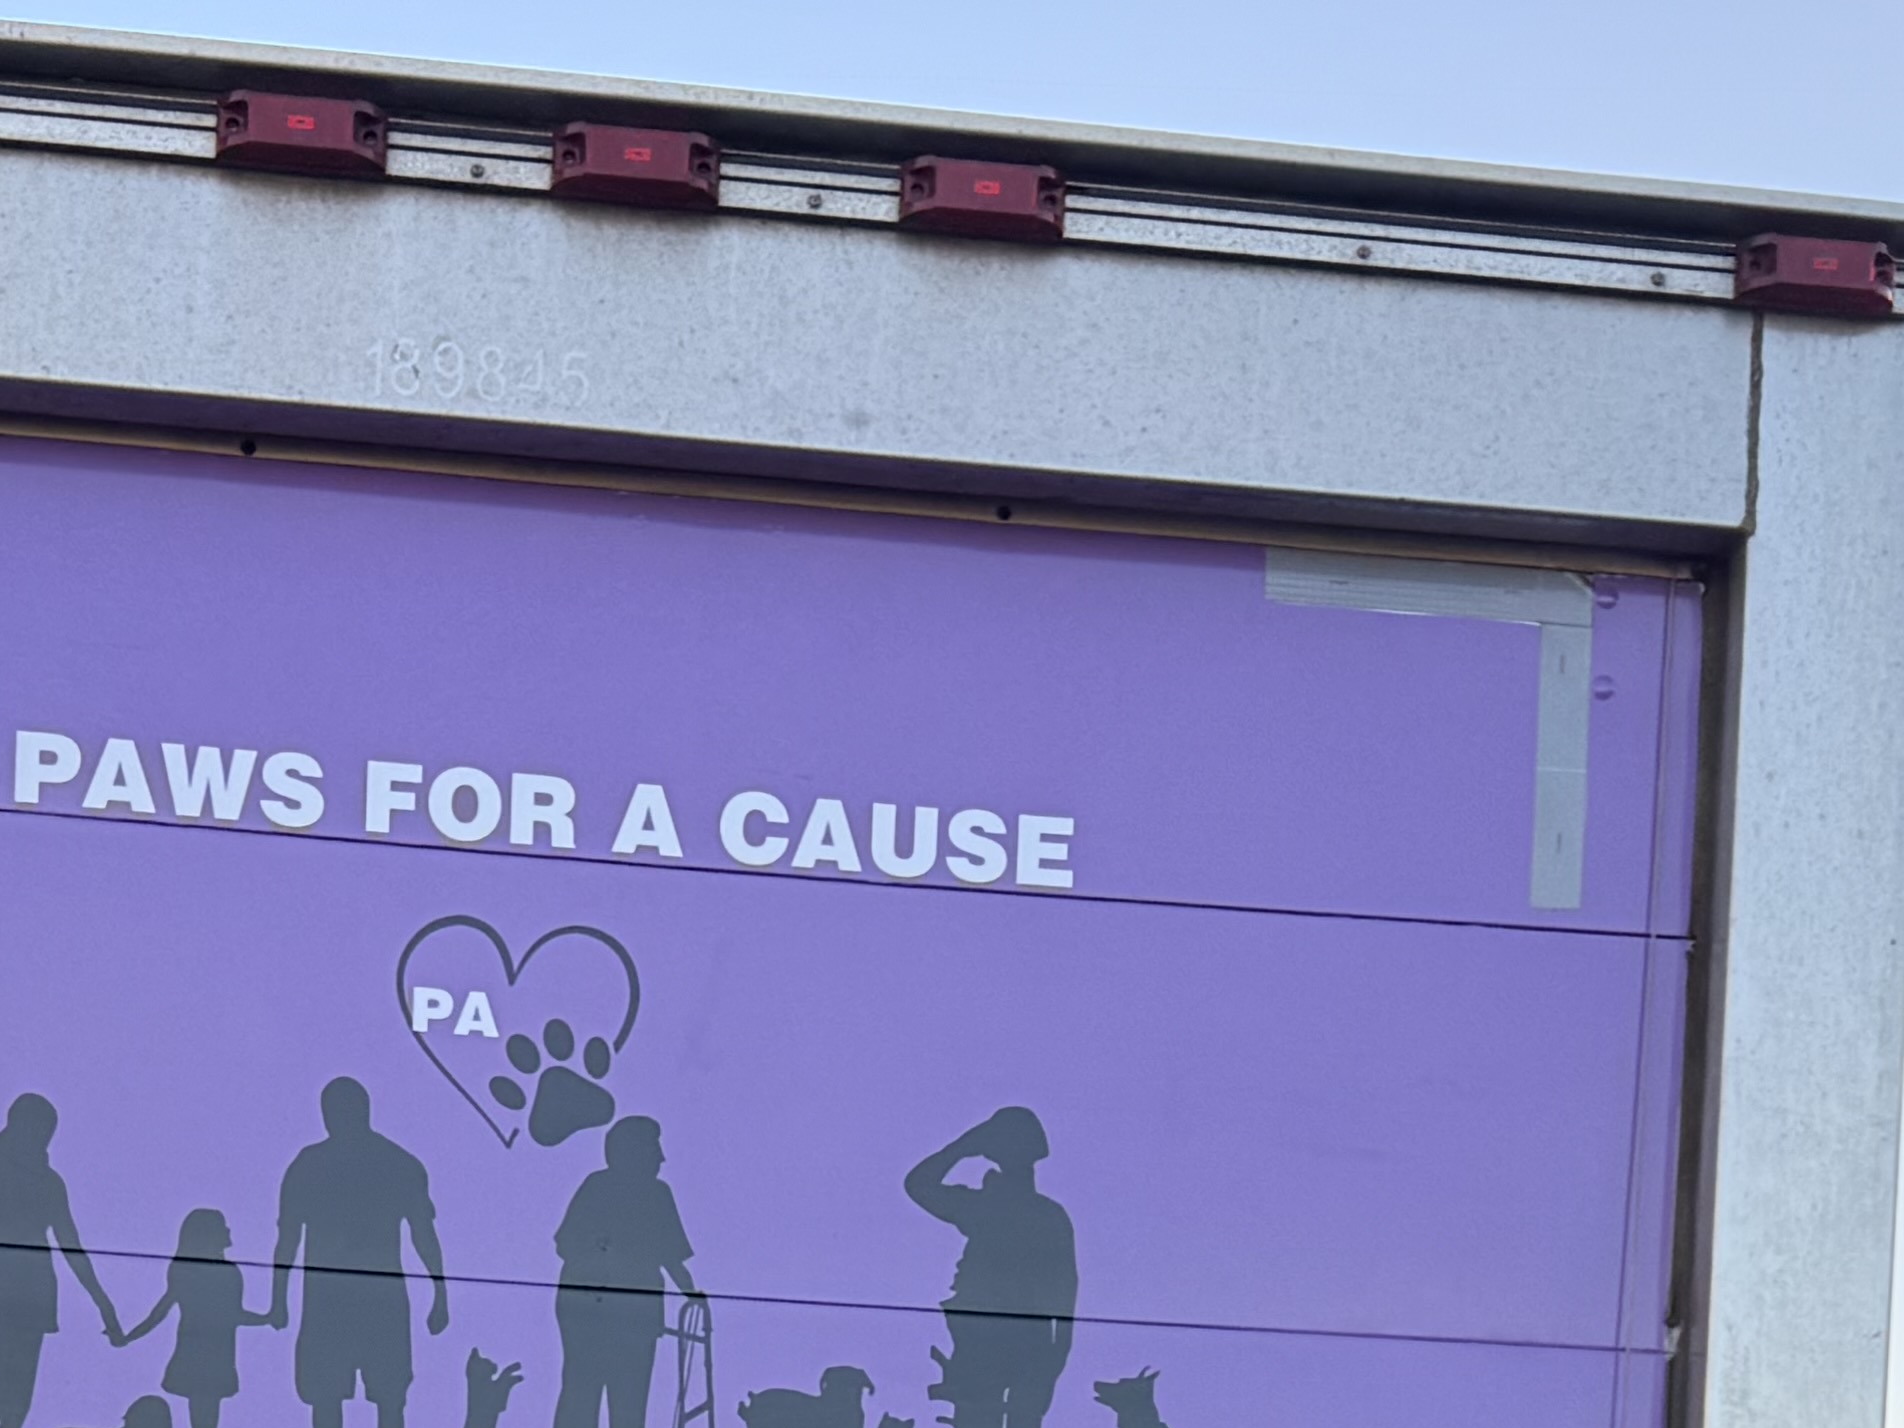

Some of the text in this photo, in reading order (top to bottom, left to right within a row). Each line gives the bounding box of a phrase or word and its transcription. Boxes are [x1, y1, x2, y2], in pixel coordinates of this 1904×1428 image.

[14, 730, 1075, 888] PAWS FOR A CAUSE
[412, 986, 500, 1038] PA
